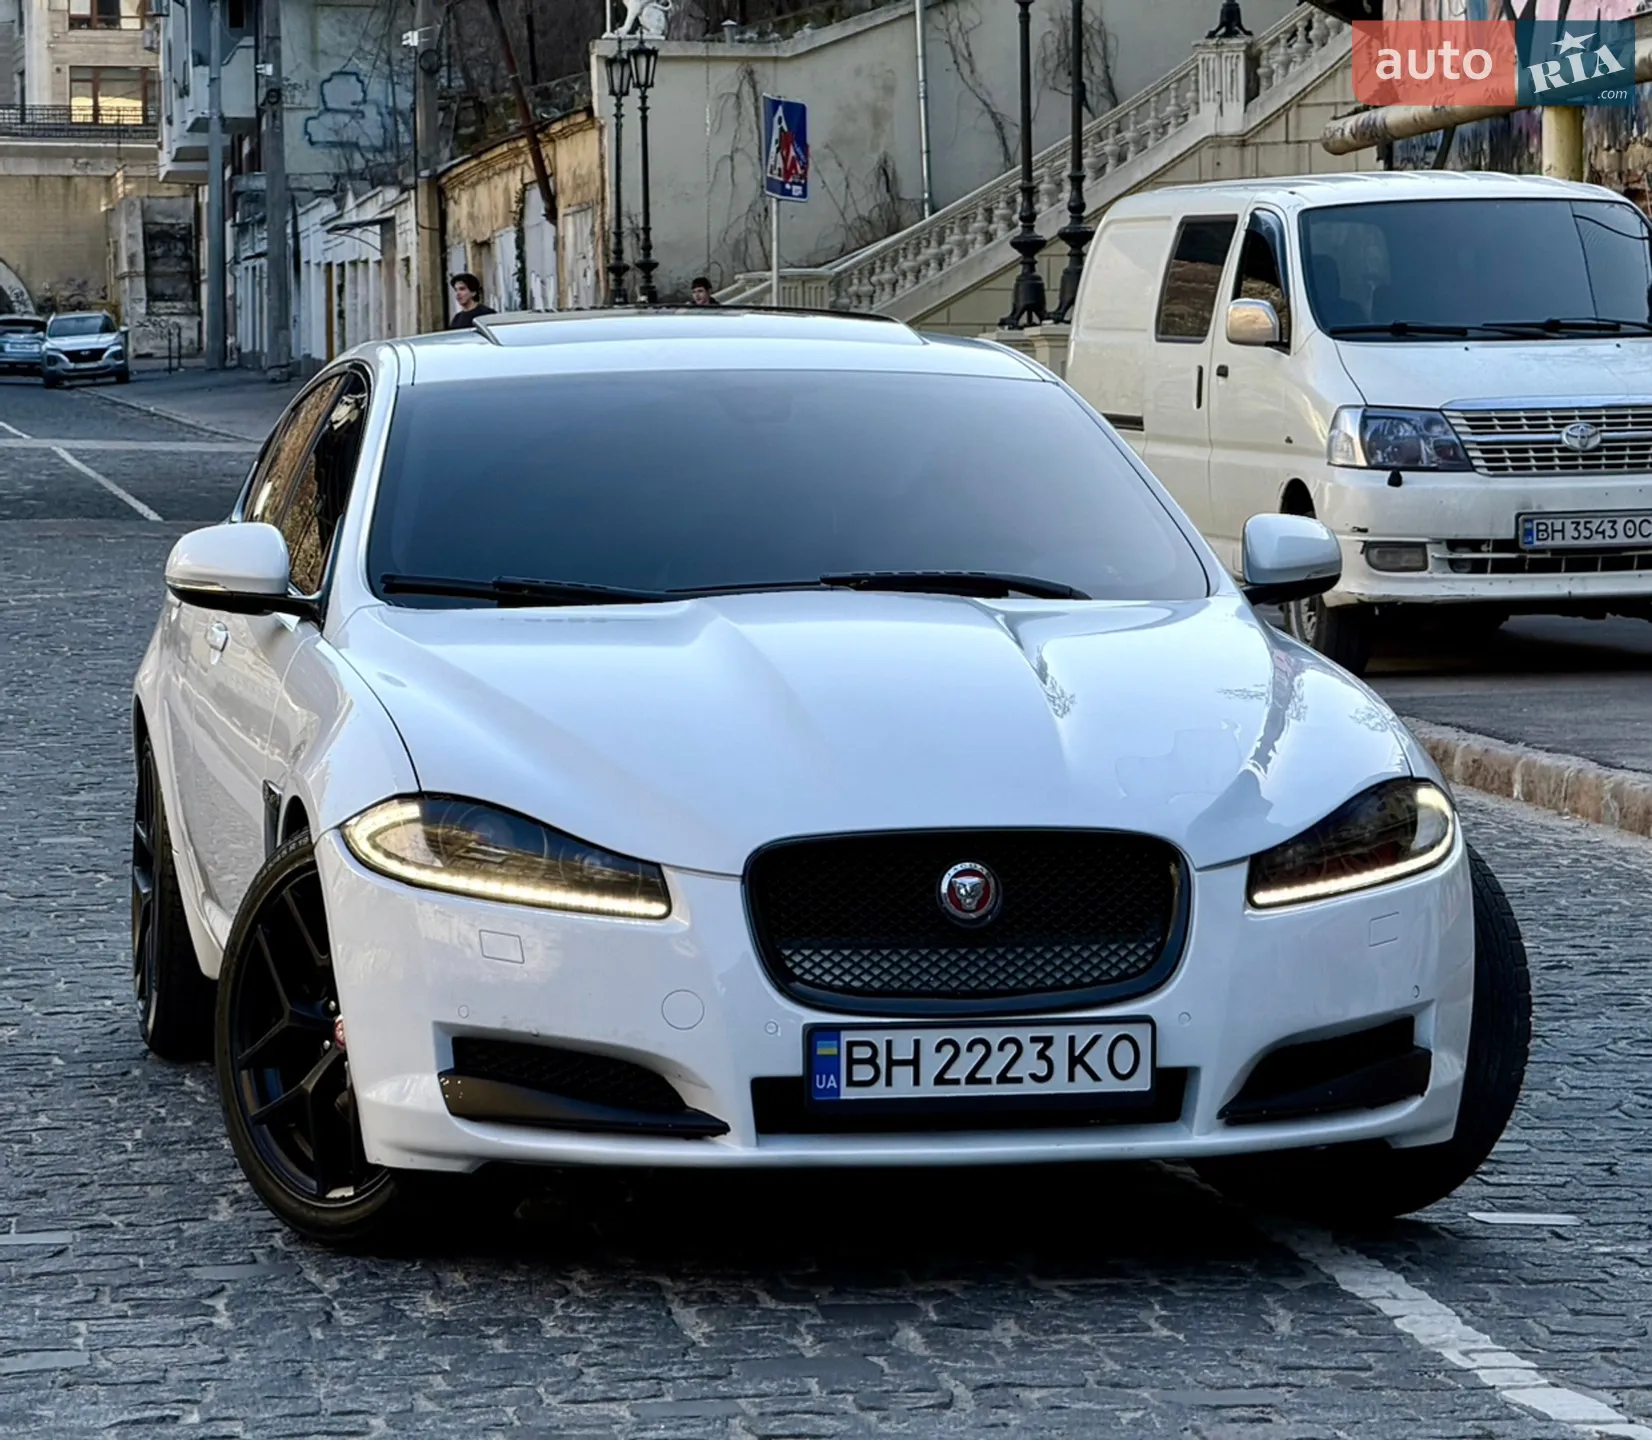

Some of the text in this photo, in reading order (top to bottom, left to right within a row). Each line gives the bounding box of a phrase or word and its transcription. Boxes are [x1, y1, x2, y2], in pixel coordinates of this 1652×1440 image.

[1535, 521, 1566, 541] BH
[1570, 519, 1619, 540] 3543
[845, 1032, 1141, 1088] BH 2223 KO
[815, 1074, 838, 1090] UA
